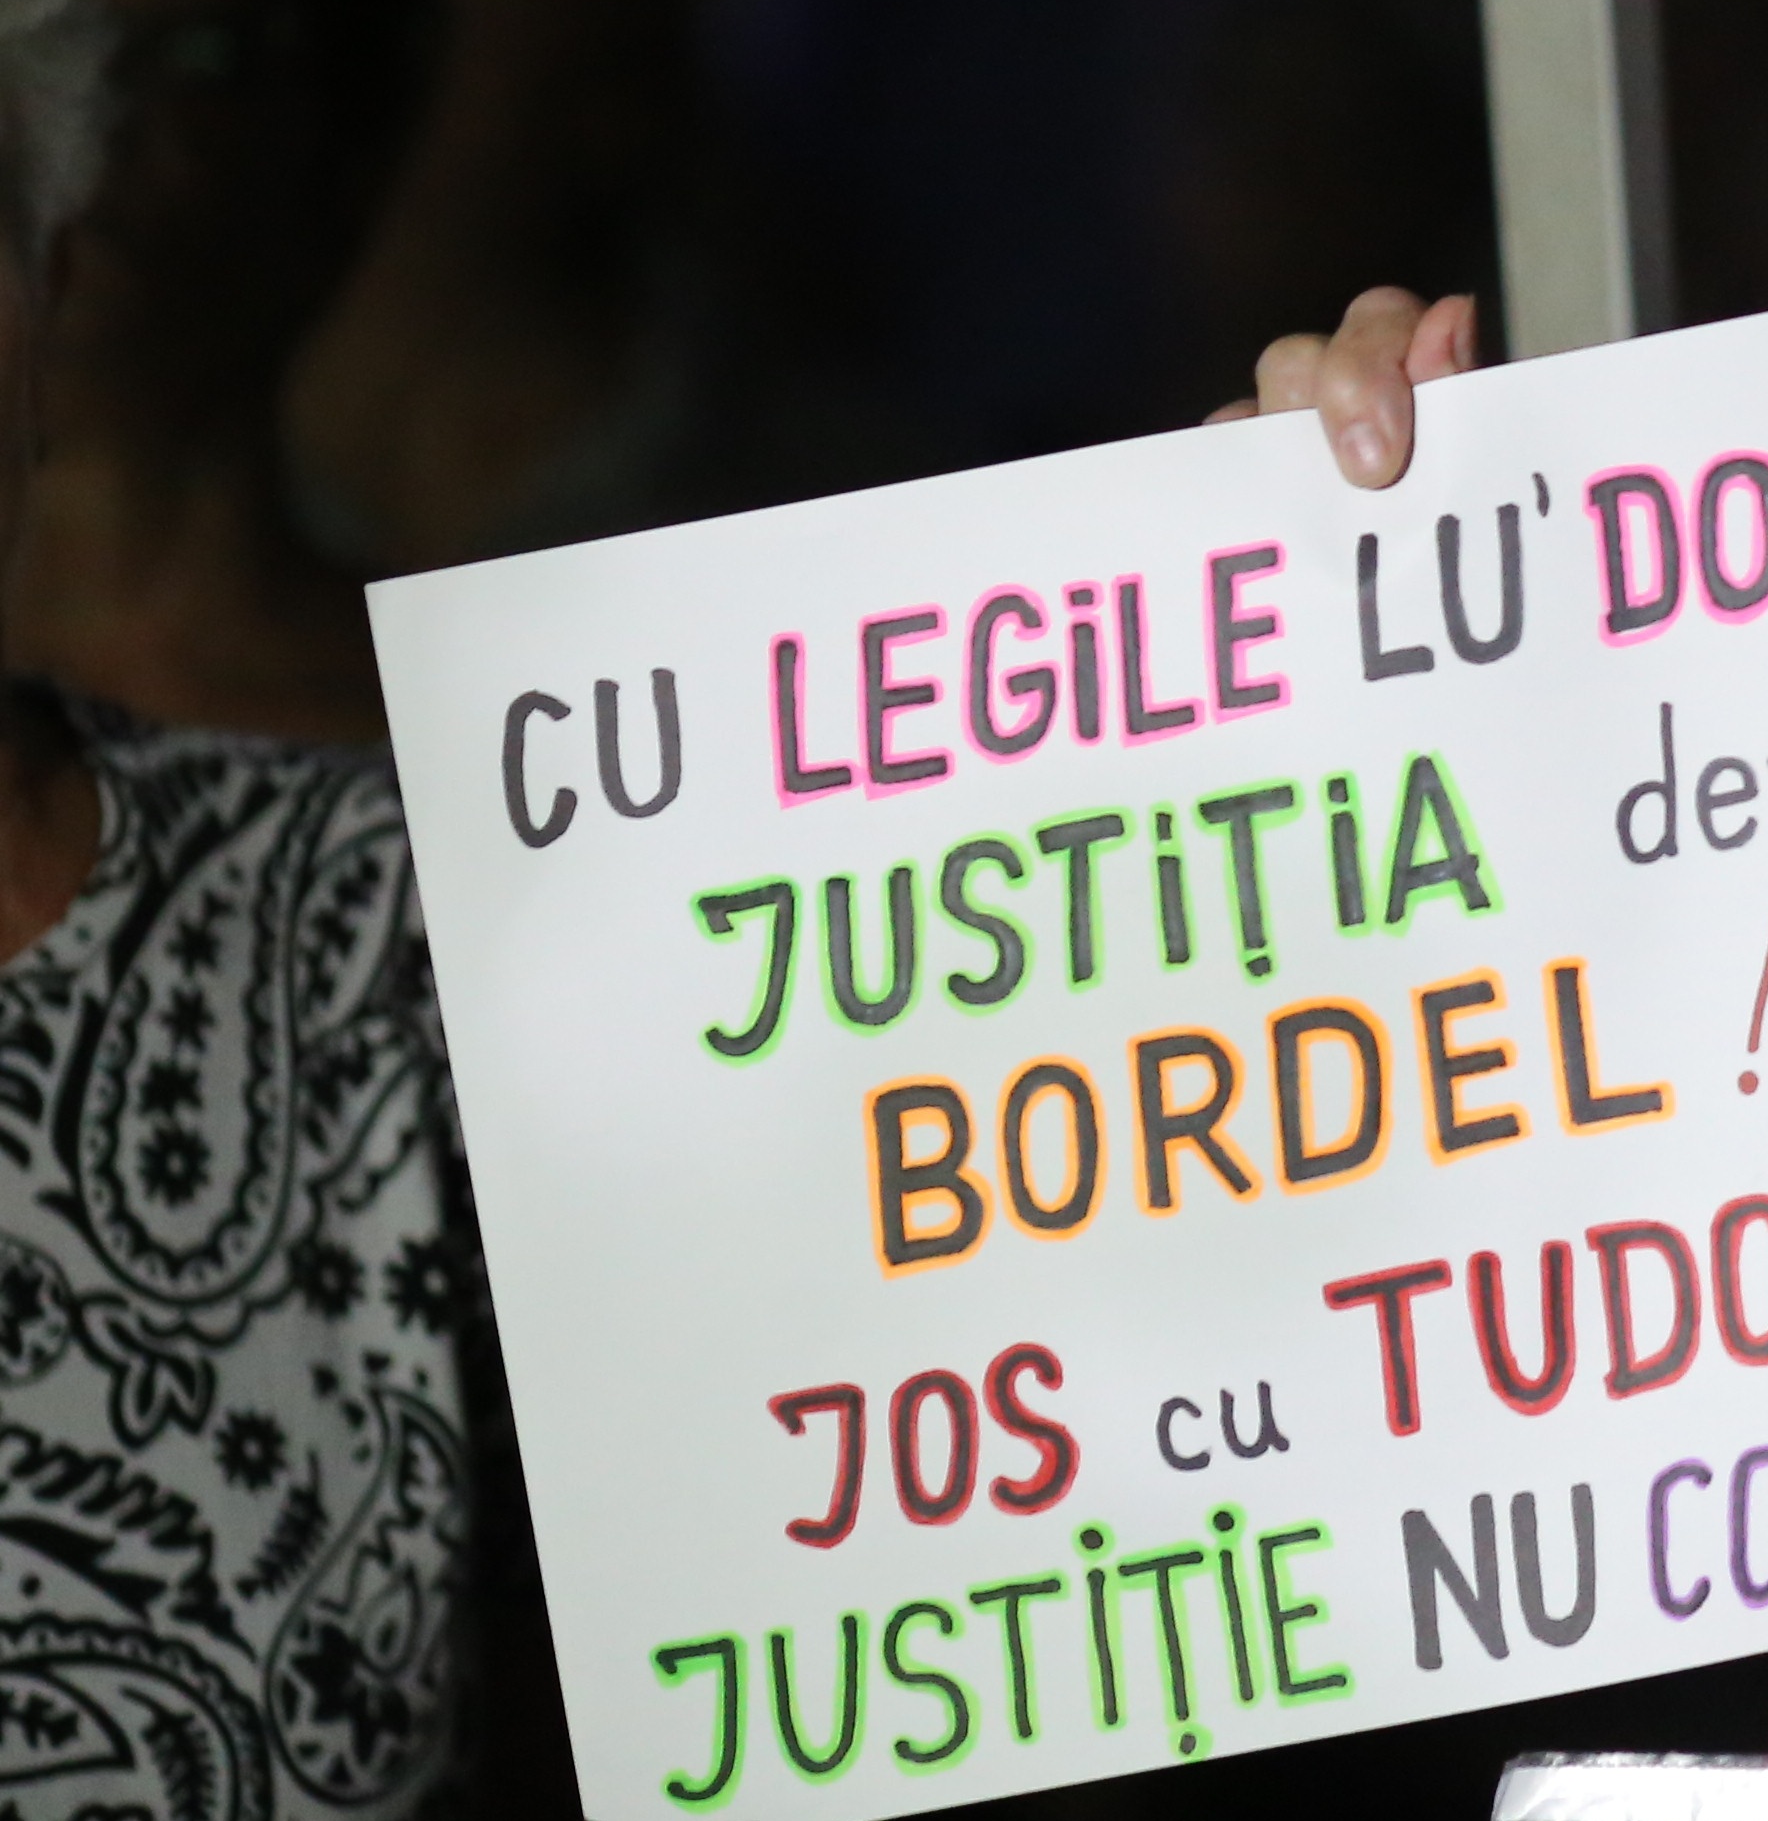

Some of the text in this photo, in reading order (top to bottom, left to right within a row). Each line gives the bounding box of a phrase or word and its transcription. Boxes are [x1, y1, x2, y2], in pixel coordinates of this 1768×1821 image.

[502, 667, 682, 848] CU
[862, 958, 1676, 1278] BORDEL
[767, 1341, 1082, 1550] JOS
[1156, 1379, 1290, 1472] cu
[1400, 1482, 1596, 1672] NU
